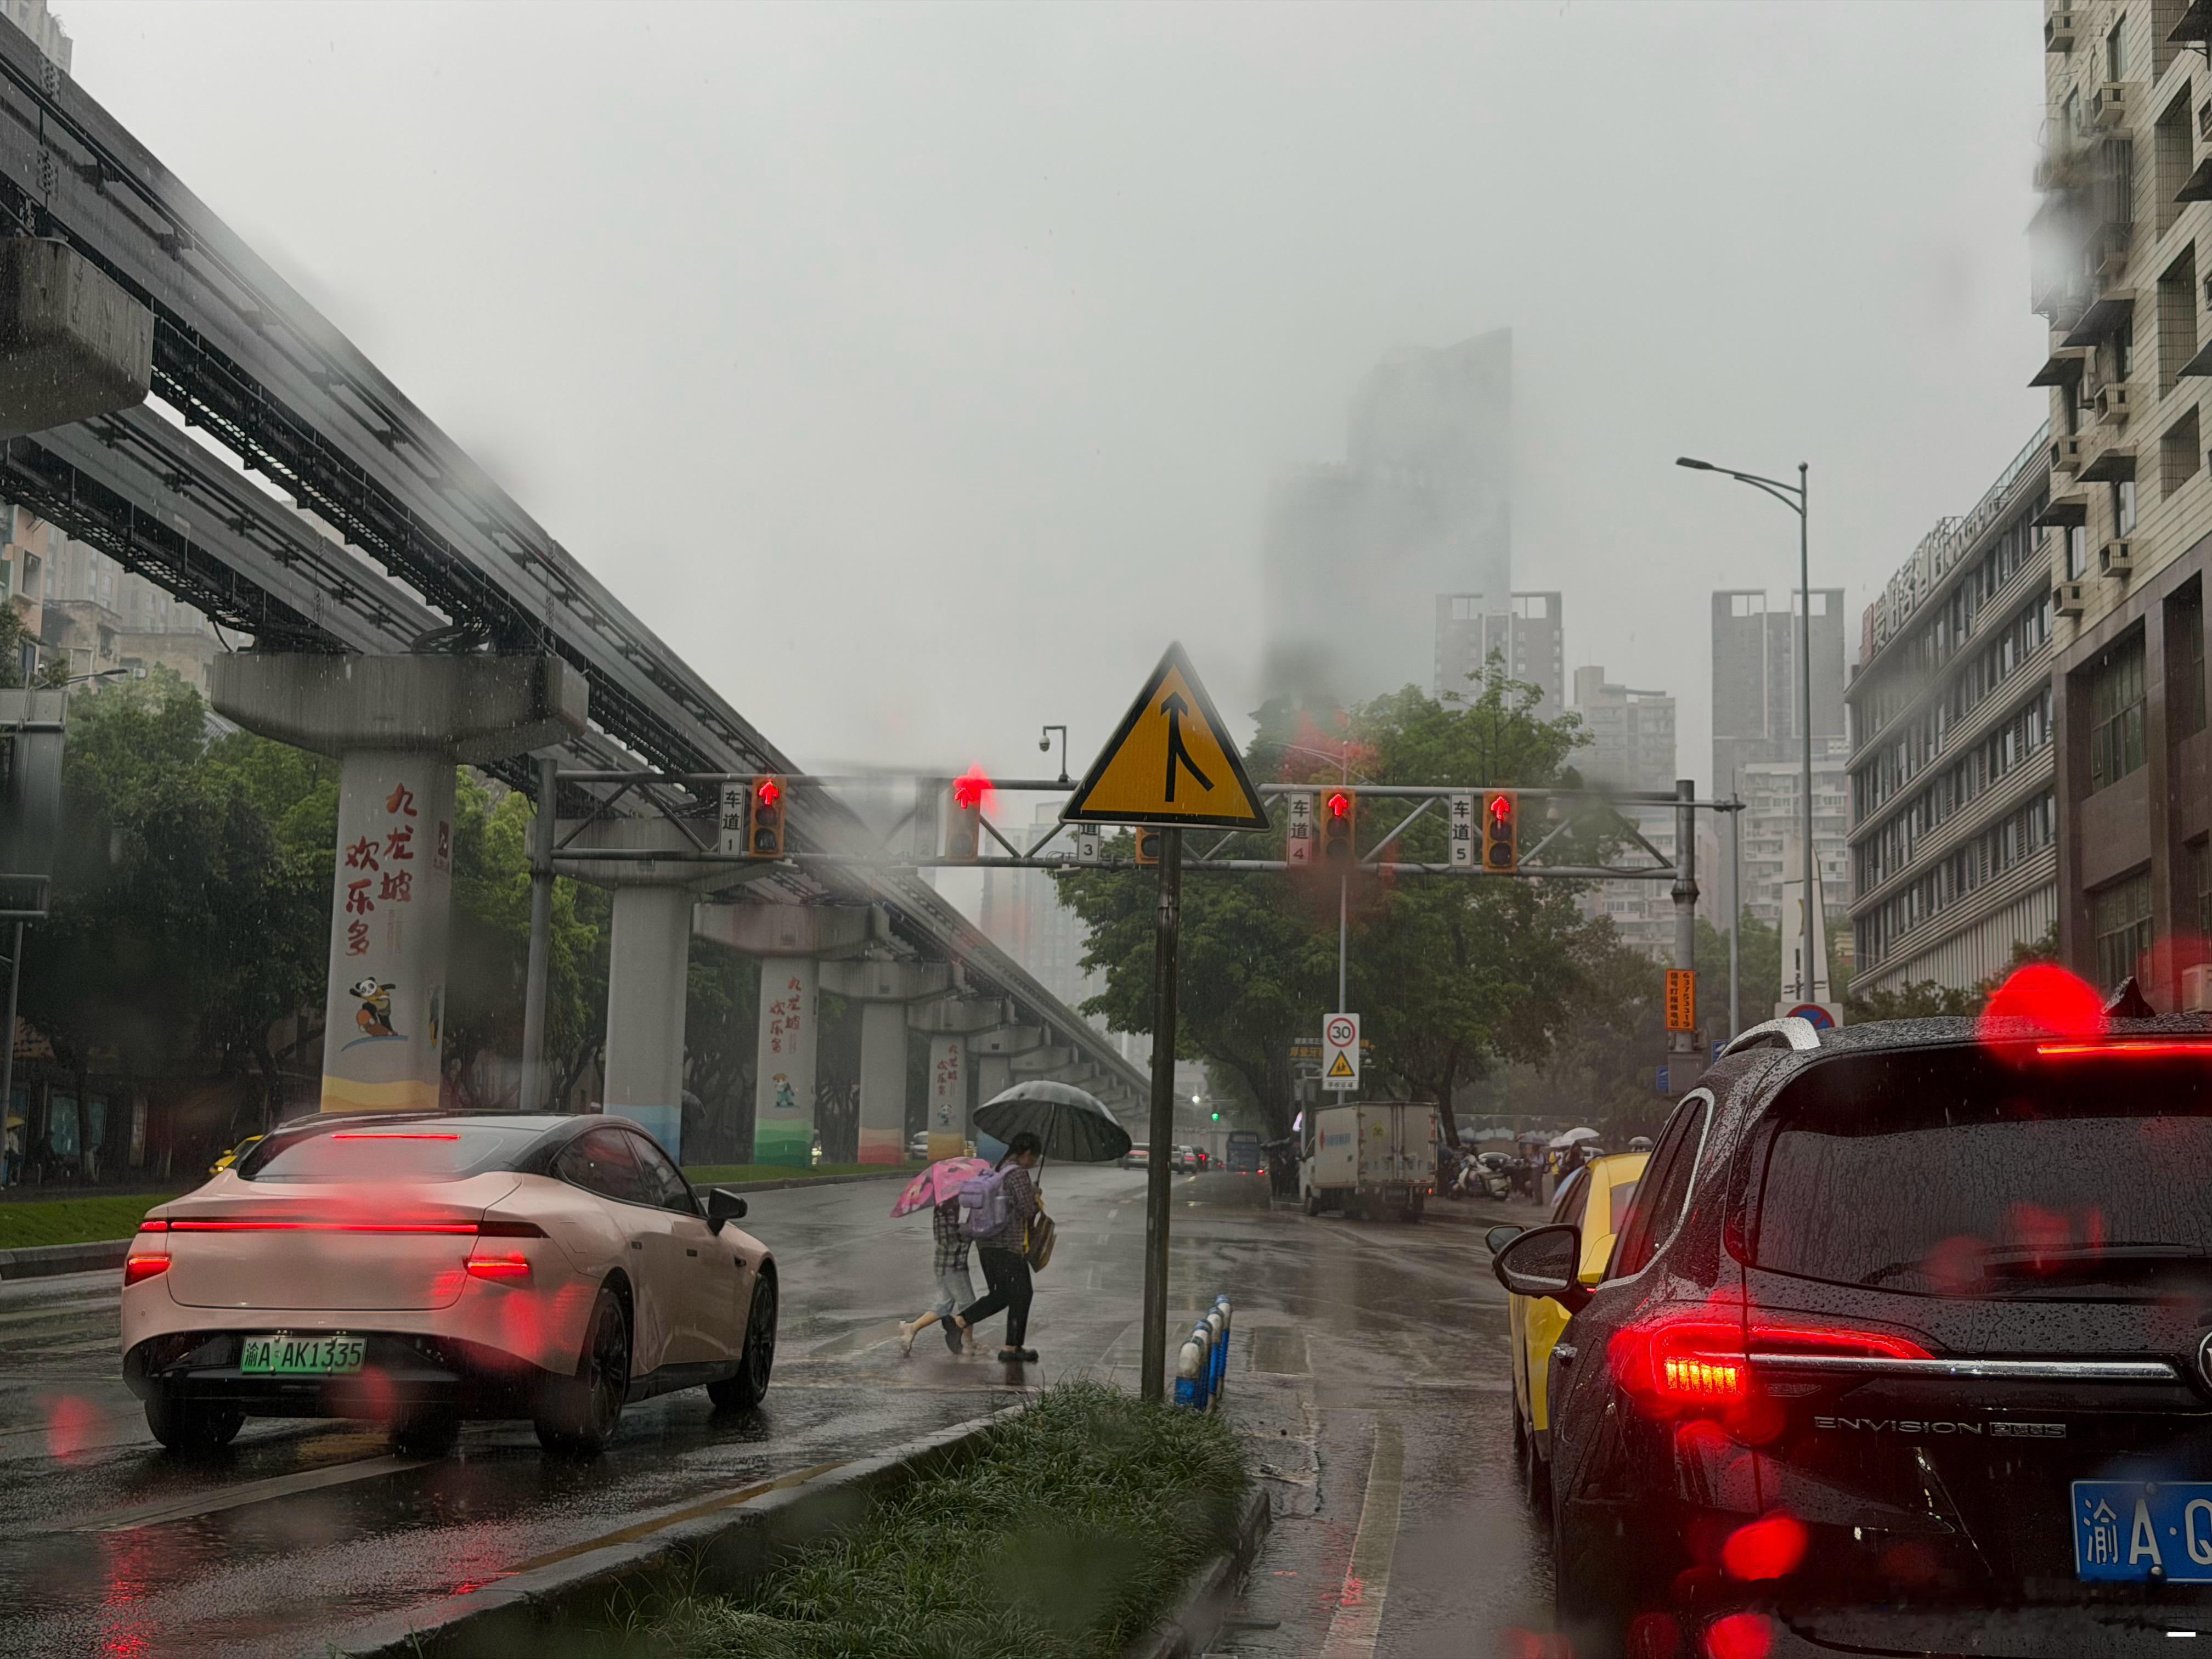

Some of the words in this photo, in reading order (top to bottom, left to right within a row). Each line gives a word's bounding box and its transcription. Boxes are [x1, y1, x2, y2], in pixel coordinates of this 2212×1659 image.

[377, 782, 417, 902] 九龙坡
[345, 835, 379, 957] 欢乐多
[1331, 1025, 1352, 1039] 30
[1814, 1416, 1983, 1434] ENVISION
[1991, 1423, 2065, 1437] PLUS
